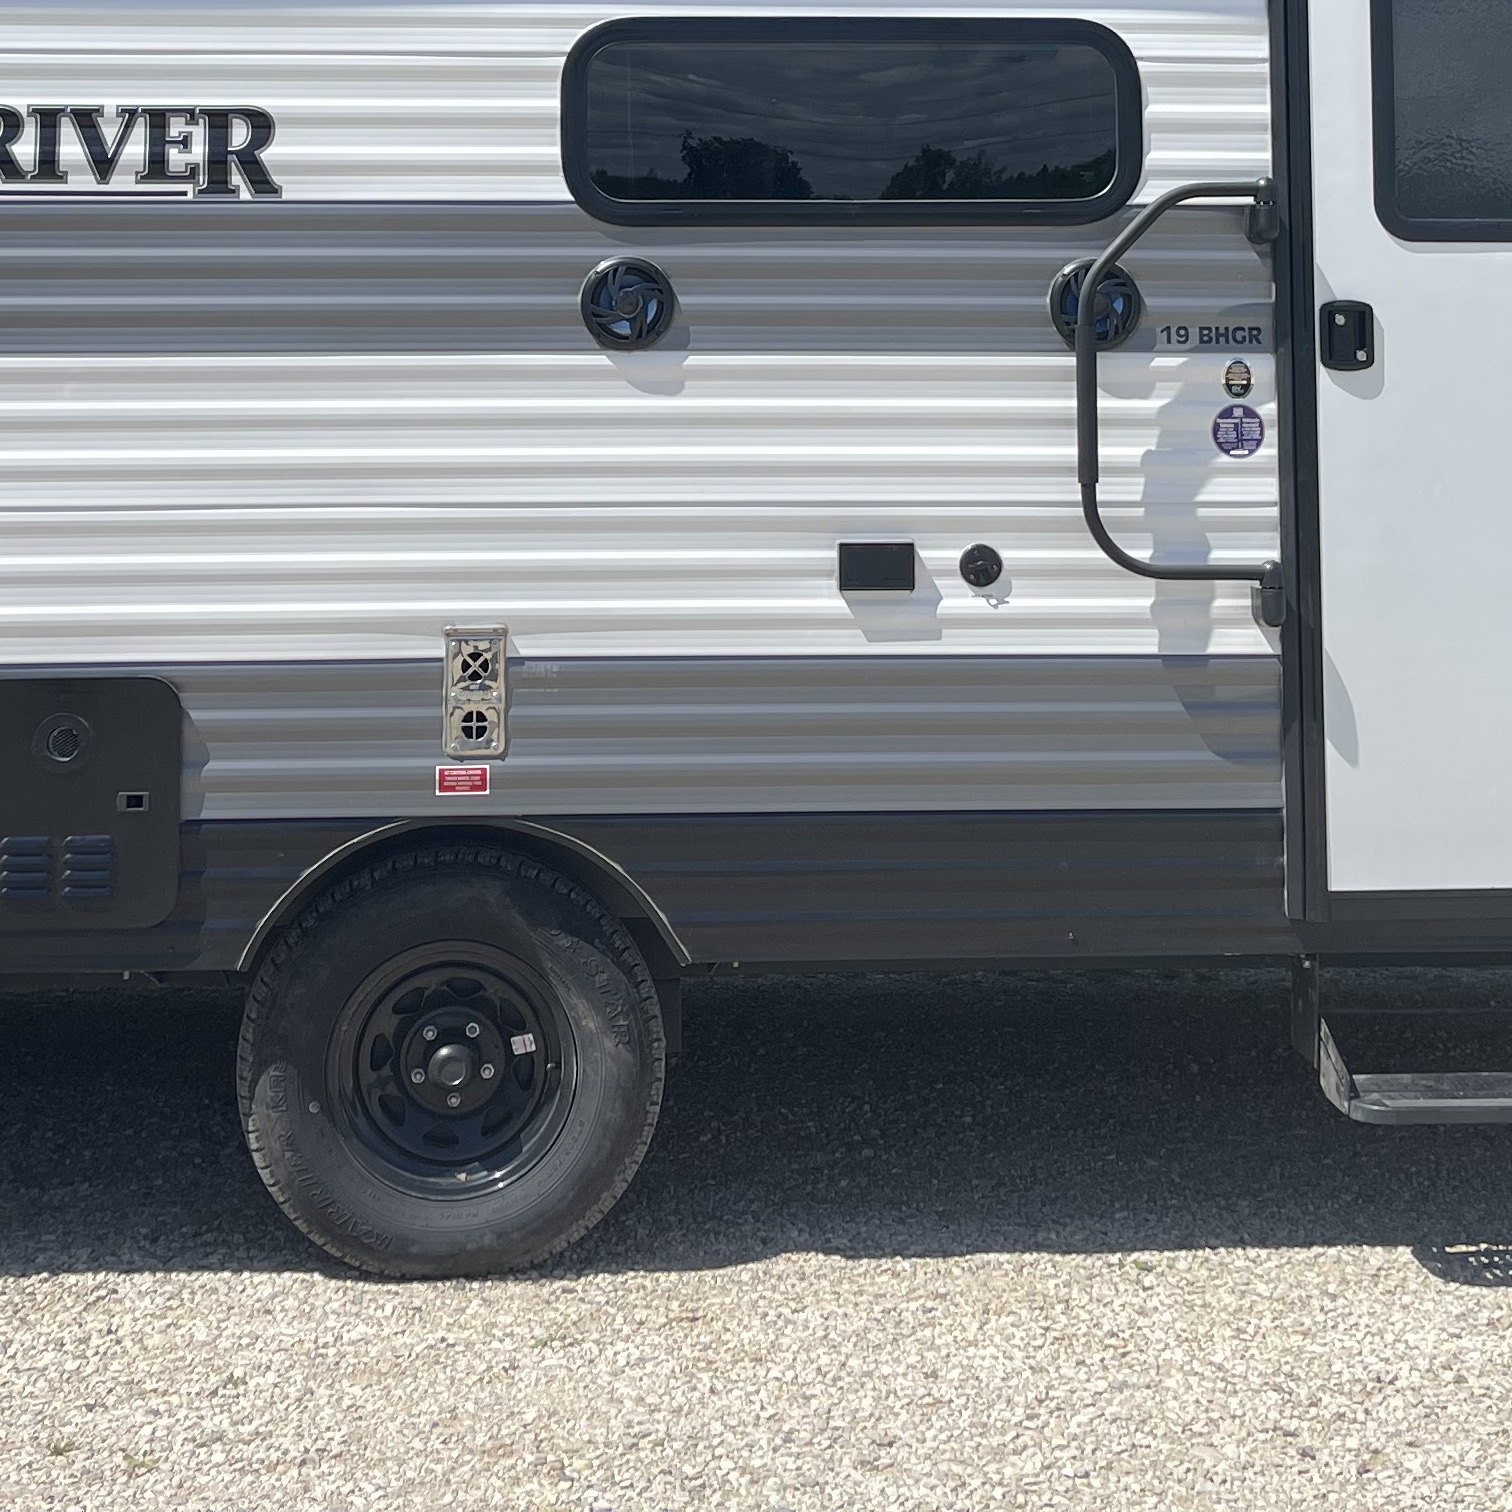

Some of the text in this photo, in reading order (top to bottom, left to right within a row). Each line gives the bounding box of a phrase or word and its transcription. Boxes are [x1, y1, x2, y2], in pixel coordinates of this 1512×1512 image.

[1160, 325, 1263, 345] 19 BHGR
[277, 1129, 394, 1251] KARRIER
